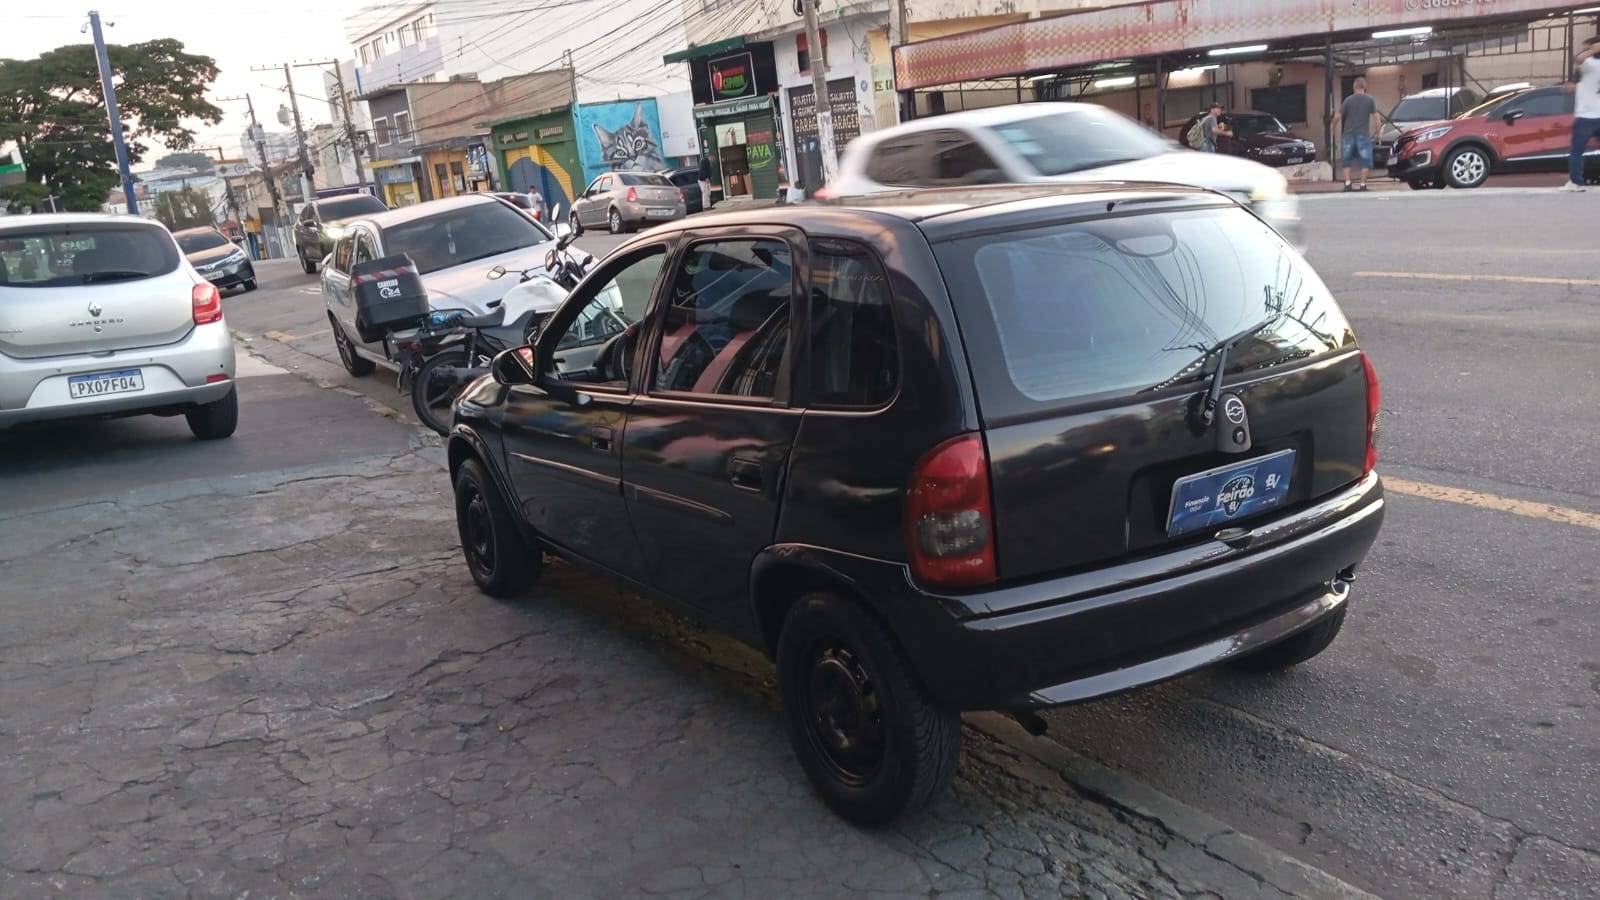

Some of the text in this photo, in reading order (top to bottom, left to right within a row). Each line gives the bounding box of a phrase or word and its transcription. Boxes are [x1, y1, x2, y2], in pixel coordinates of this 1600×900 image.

[797, 104, 817, 117] GUINC
[794, 114, 860, 133] GARAG ARAGE
